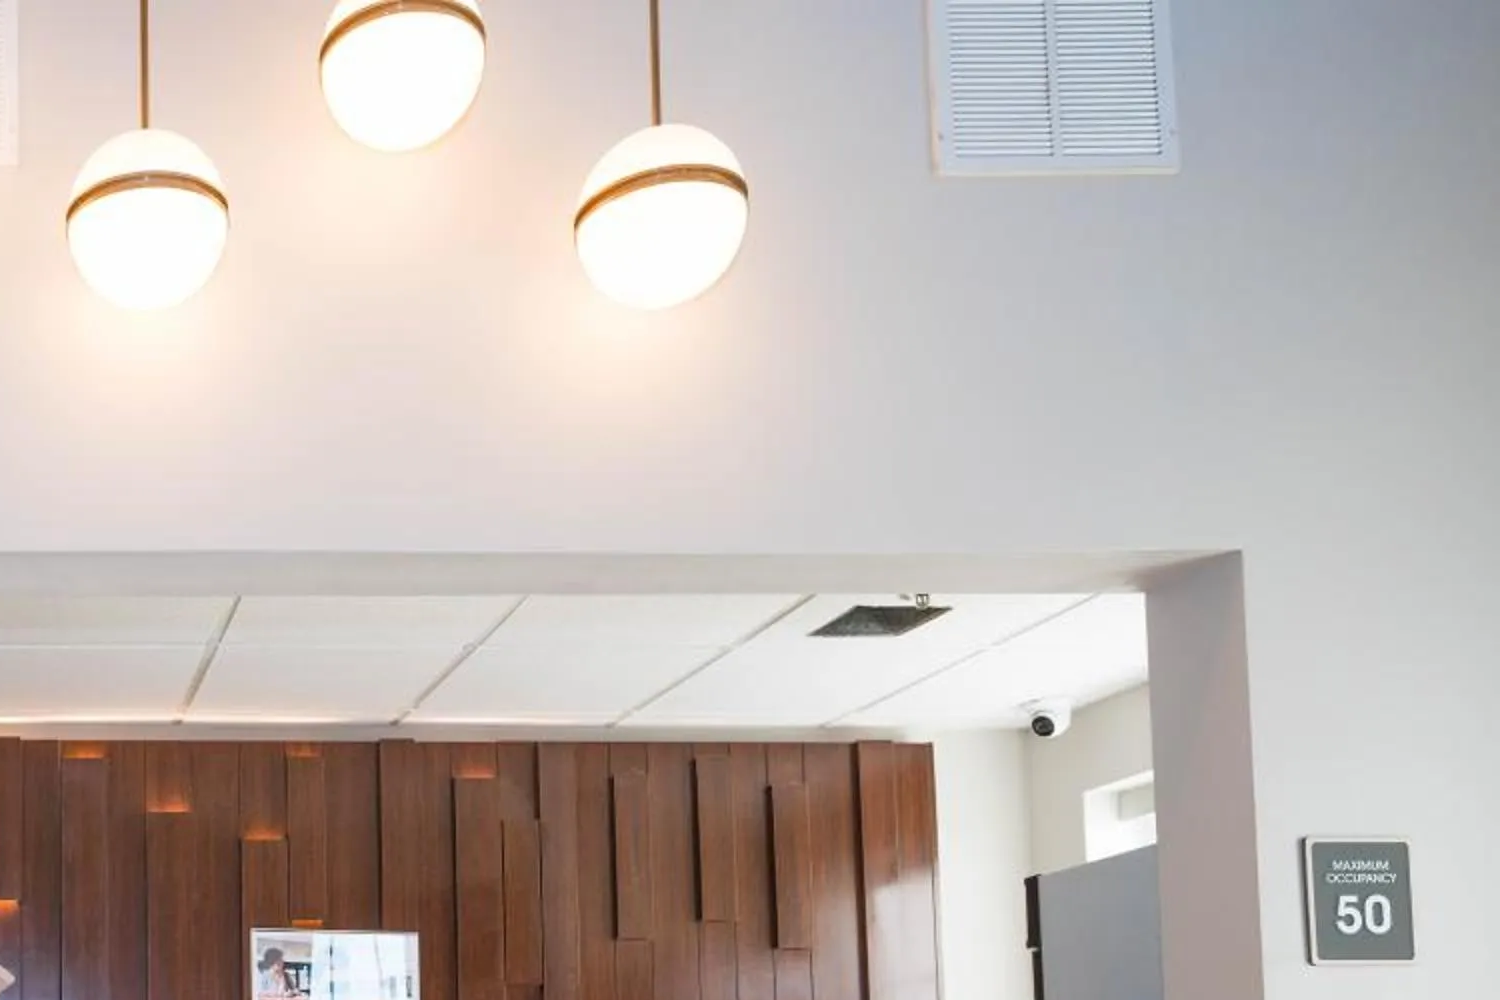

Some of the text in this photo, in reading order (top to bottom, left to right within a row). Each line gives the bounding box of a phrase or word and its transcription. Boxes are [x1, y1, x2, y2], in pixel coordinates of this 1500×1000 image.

[1332, 859, 1390, 871] MAXIMUM
[1325, 873, 1397, 884] OCCUPANCY
[1336, 894, 1391, 935] 50
